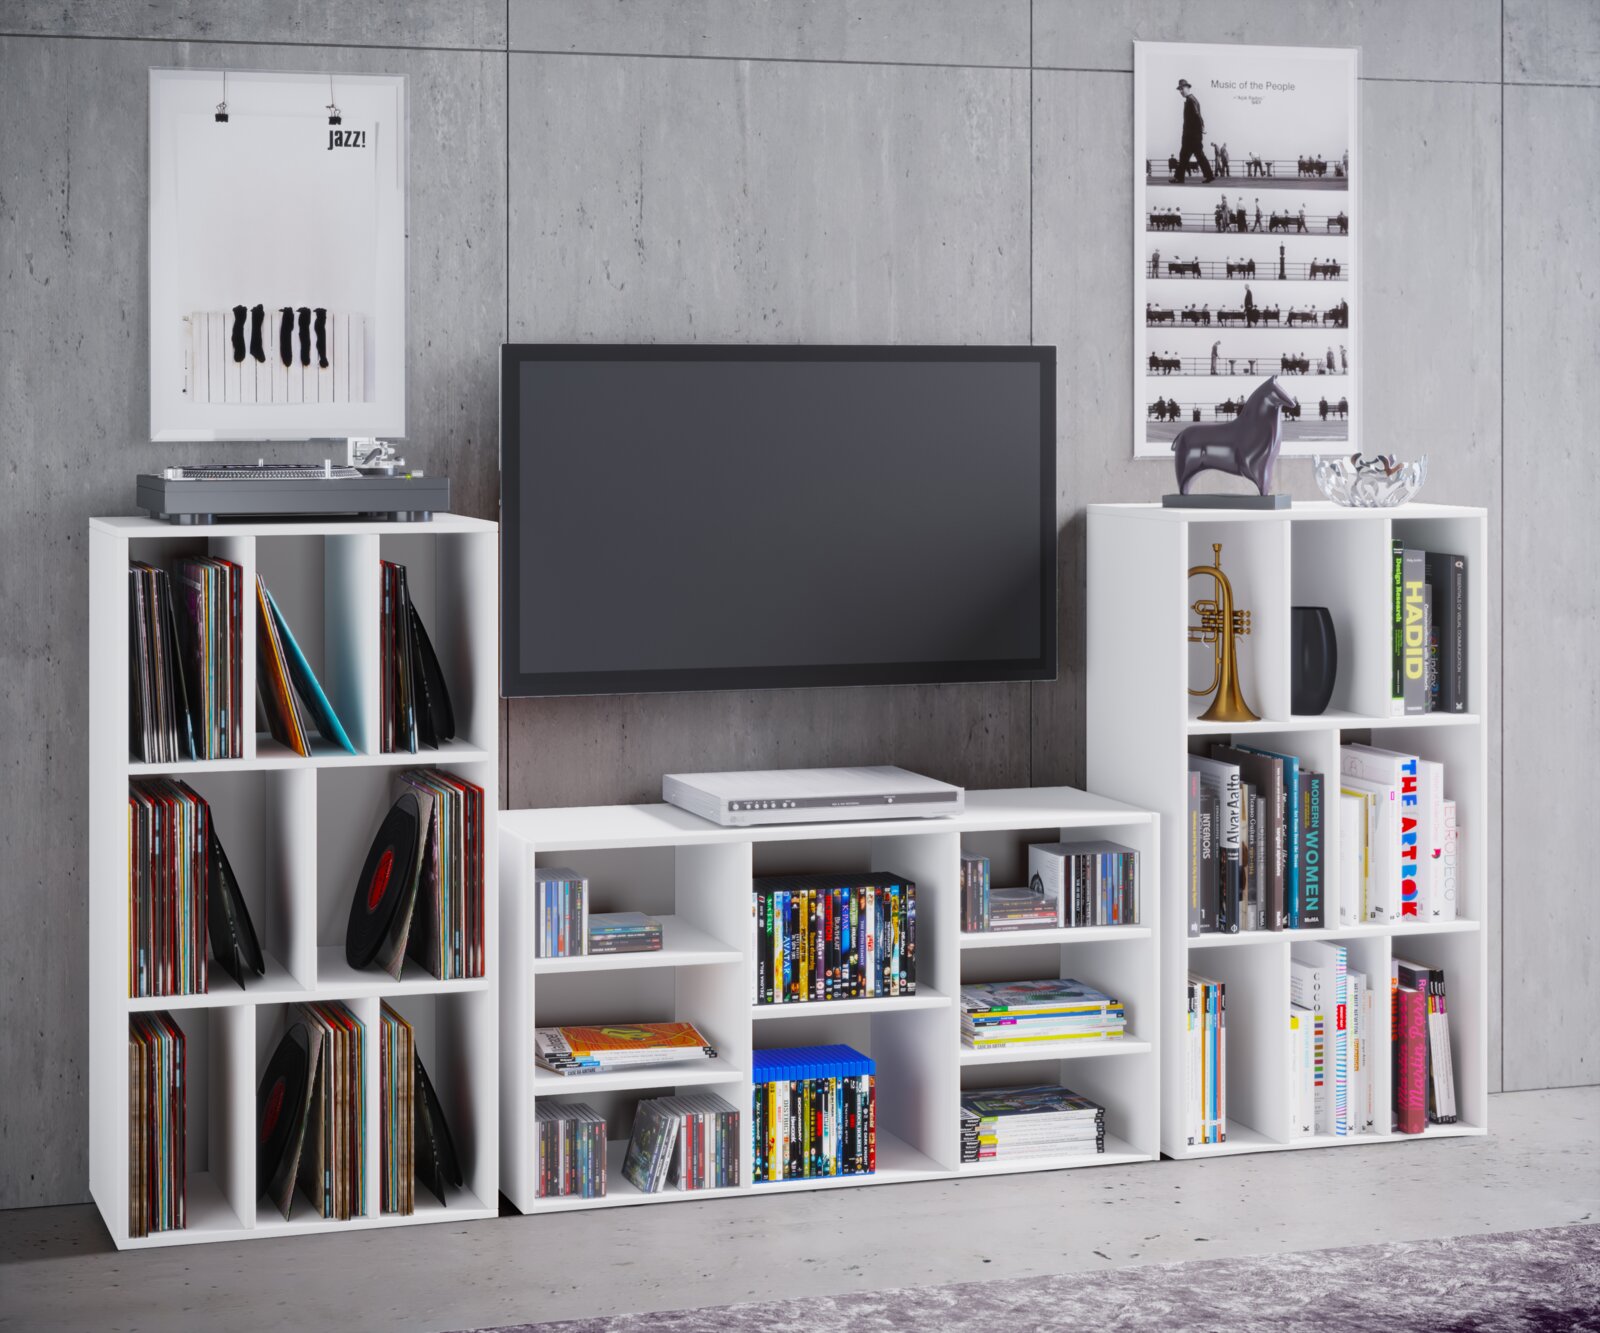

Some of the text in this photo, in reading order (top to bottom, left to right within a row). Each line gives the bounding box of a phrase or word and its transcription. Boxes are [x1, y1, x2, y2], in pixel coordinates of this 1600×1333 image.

[1211, 80, 1296, 91] Music of the People
[327, 130, 366, 150] jazz!
[1394, 558, 1402, 584] Design
[1405, 581, 1423, 679] HADID
[1311, 779, 1319, 828] MODERN
[1401, 759, 1417, 807] THE
[1227, 774, 1240, 844] Alvar Aalto
[1203, 813, 1211, 859] INTERIORS
[1401, 817, 1417, 860] ART
[1444, 807, 1456, 901] EURODECO
[1305, 830, 1319, 911] WOMEN
[1408, 994, 1425, 1039] Parr
[1408, 1043, 1424, 1107] Martin
